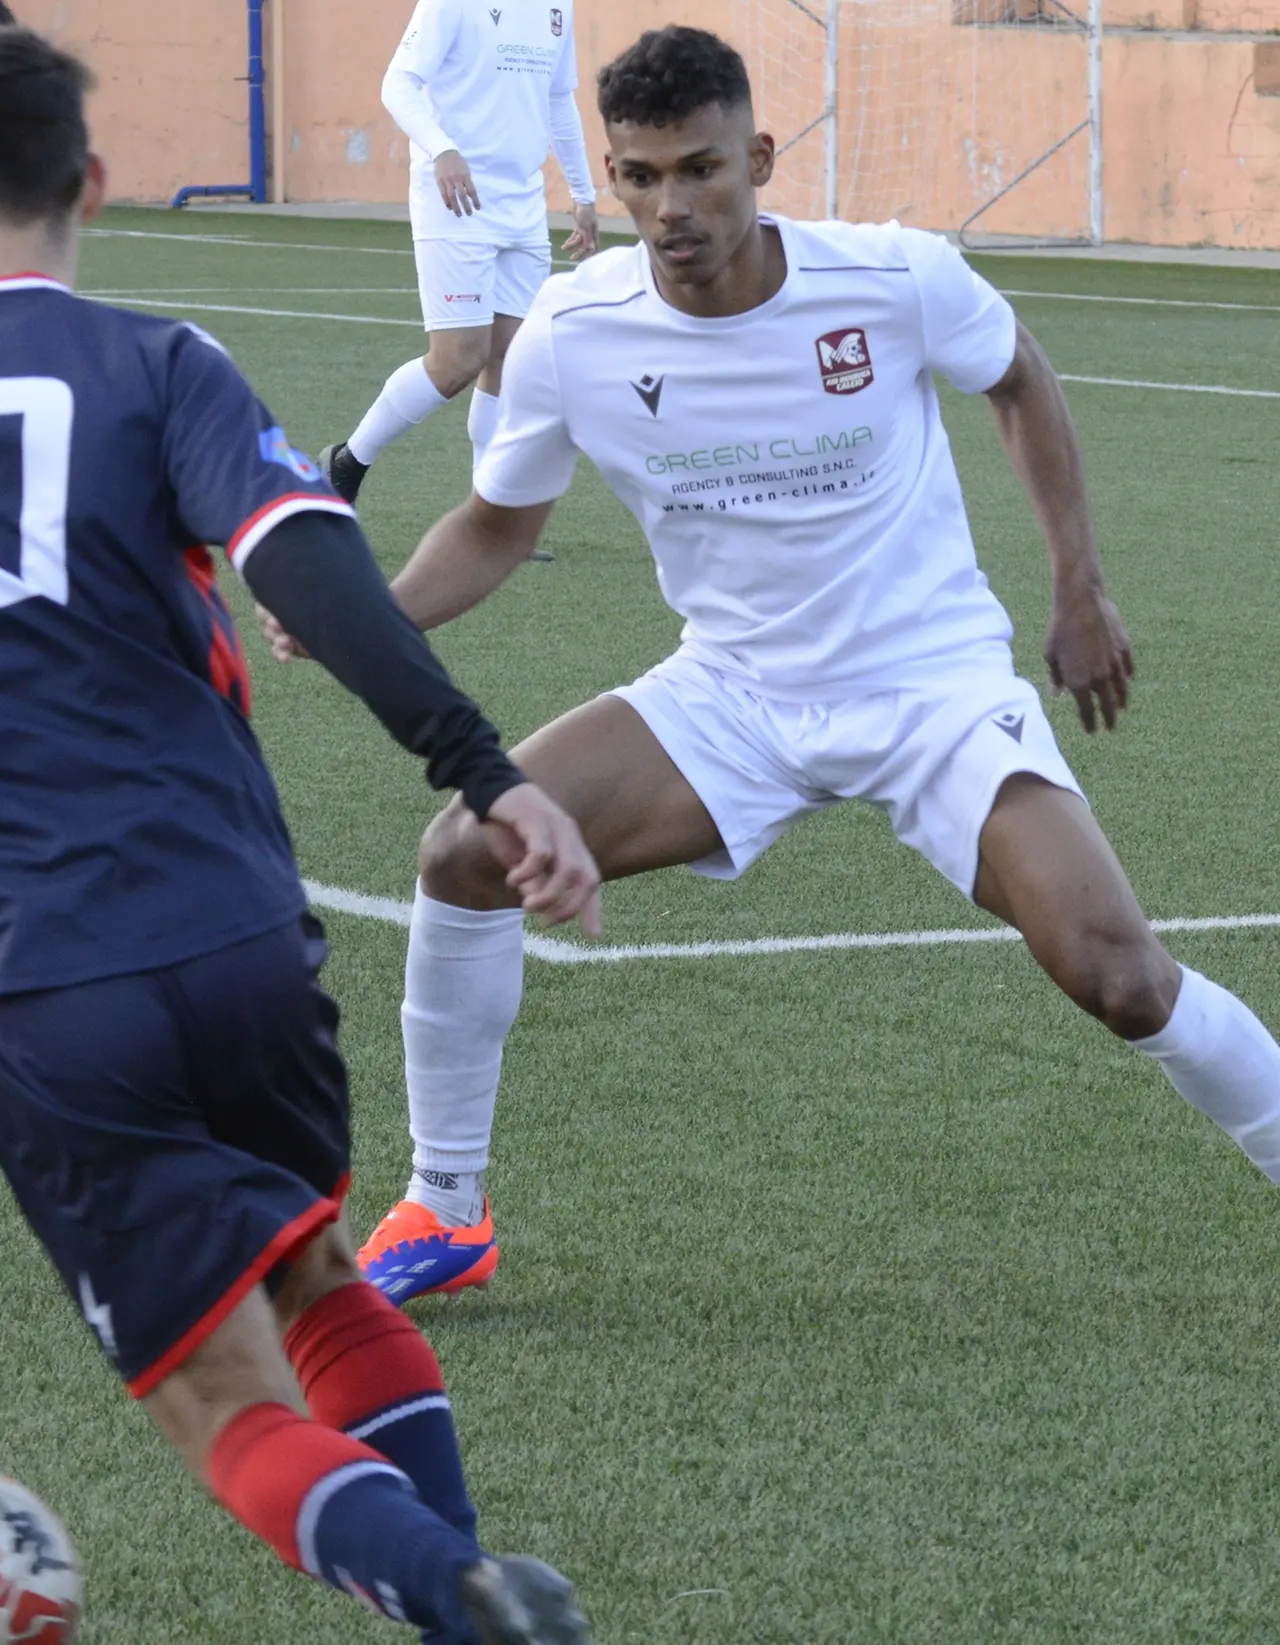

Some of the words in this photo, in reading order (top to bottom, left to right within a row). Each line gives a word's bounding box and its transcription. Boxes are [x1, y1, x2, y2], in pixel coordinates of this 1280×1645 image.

[646, 443, 759, 475] GREEN
[769, 426, 873, 459] CLIMA
[672, 477, 721, 495] AGENCY
[726, 475, 734, 487] &
[739, 465, 818, 486] CONSULTING
[823, 458, 857, 475] S.N.C.
